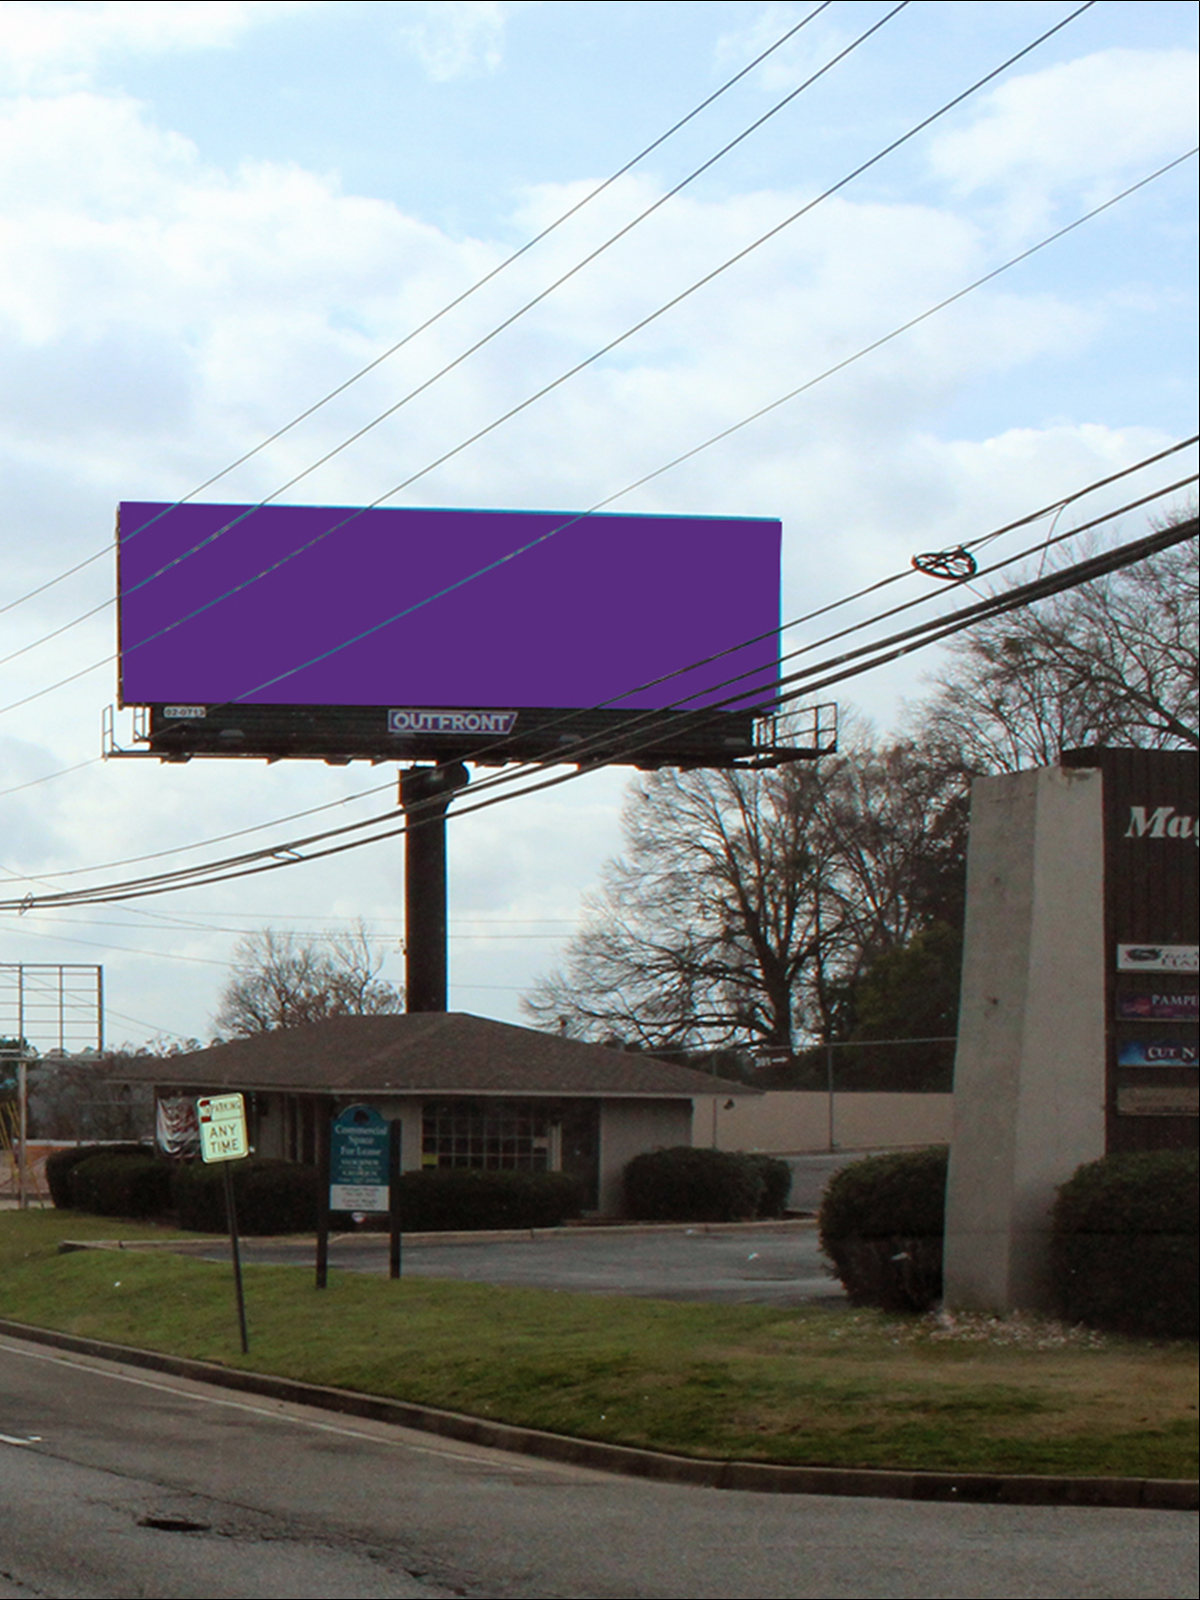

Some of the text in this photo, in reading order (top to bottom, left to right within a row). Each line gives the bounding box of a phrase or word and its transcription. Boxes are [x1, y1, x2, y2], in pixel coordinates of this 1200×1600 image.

[393, 712, 510, 731] OUTFRONT
[210, 1124, 237, 1139] ANY
[335, 1124, 387, 1135] Commercial
[210, 1138, 238, 1153] TIME
[357, 1146, 382, 1156] Lease
